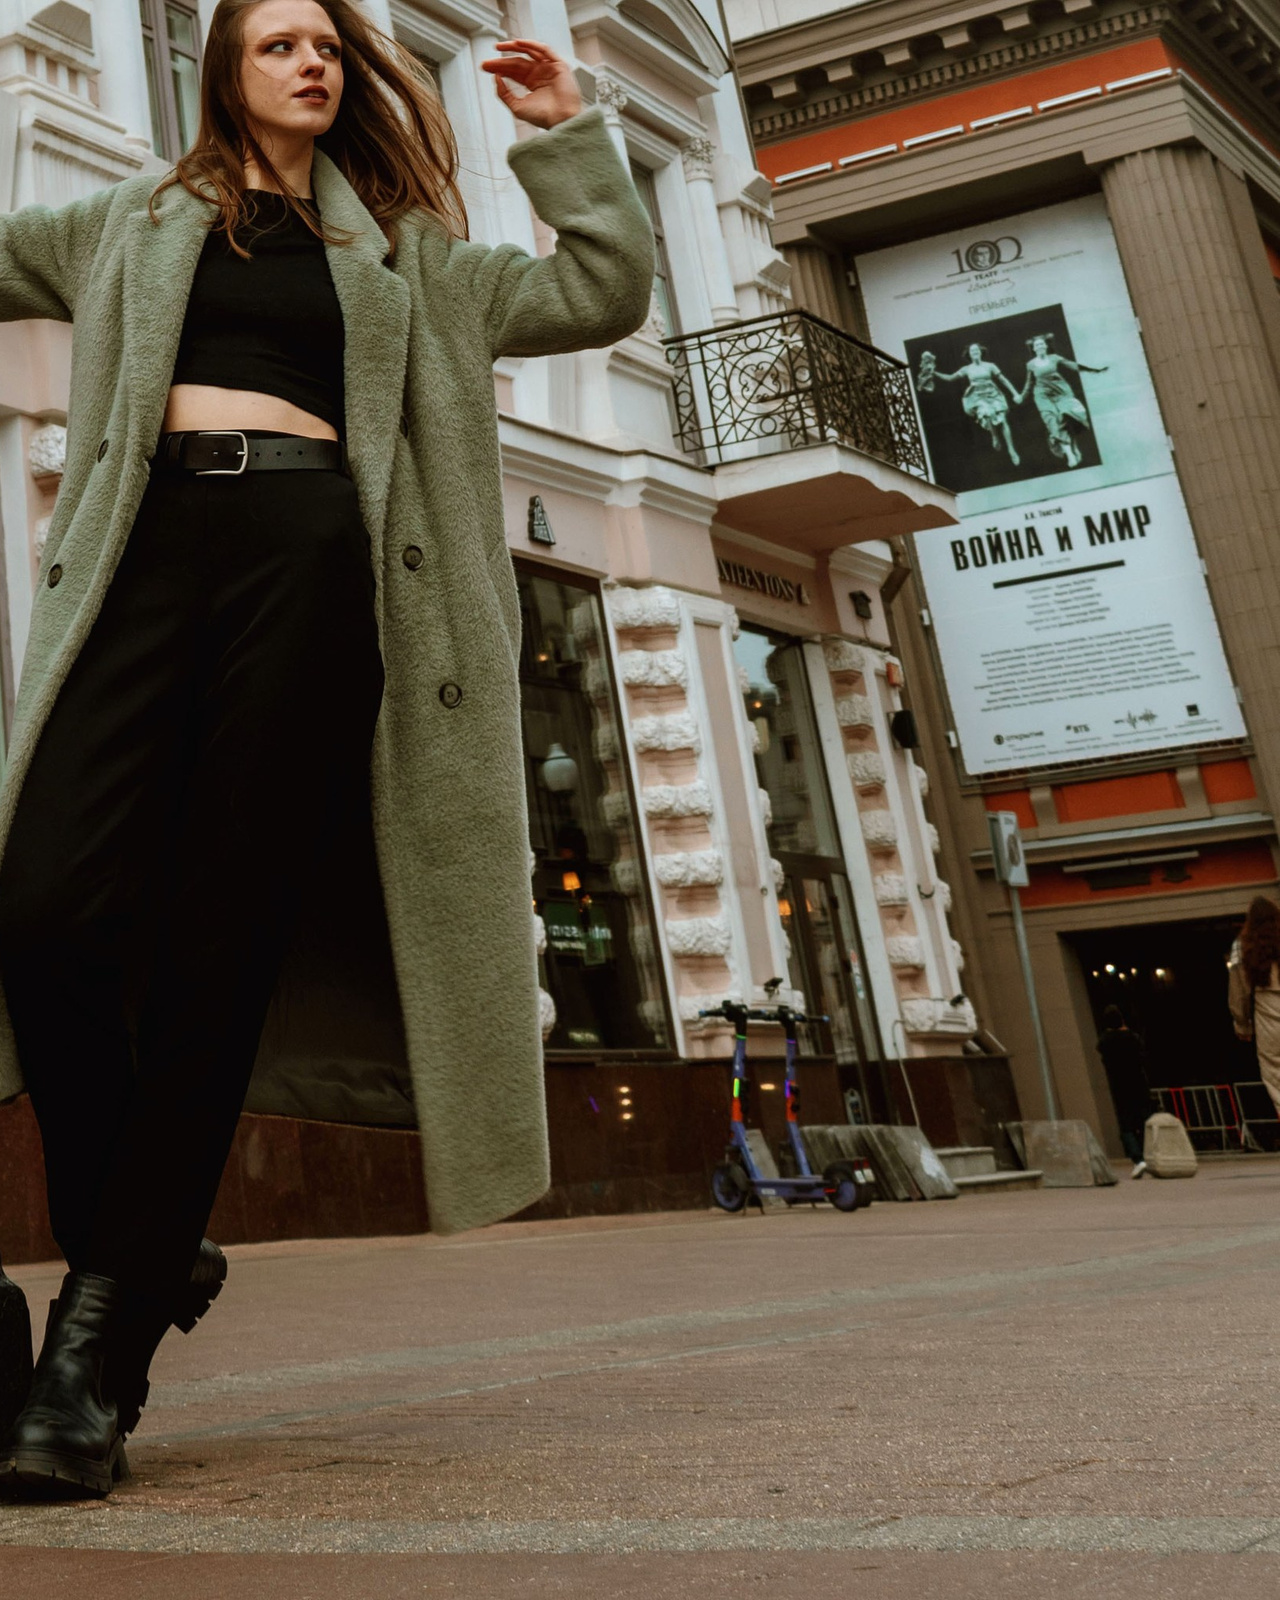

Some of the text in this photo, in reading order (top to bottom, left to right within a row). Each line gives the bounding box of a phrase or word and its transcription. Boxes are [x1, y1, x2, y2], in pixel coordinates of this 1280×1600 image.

[968, 296, 1018, 315] ПРЕМЬЕРА
[950, 526, 1044, 571] ВОЙНА
[1083, 505, 1151, 547] МИР
